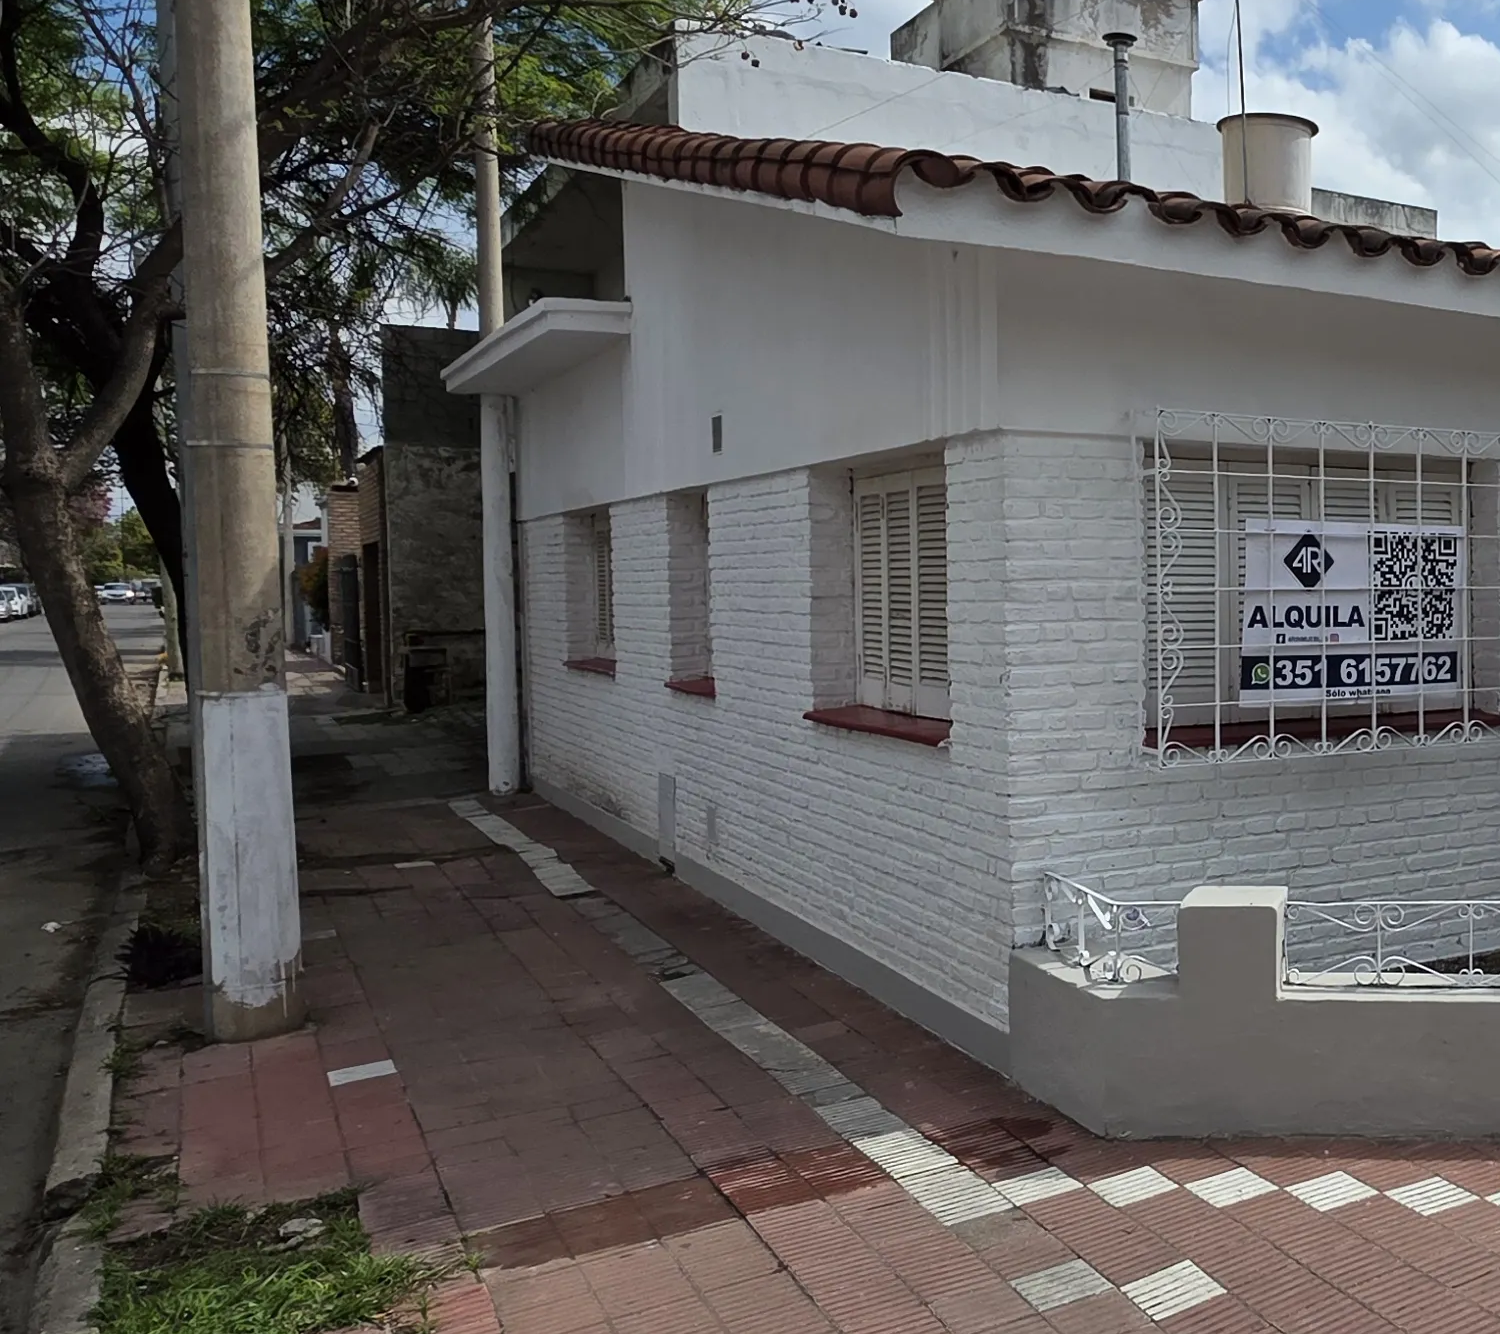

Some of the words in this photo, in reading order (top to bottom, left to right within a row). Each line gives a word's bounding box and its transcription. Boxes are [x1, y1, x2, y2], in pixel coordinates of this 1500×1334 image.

[1247, 605, 1365, 630] ALQUILA
[1340, 655, 1451, 684] 6157762
[1325, 688, 1346, 698] Sólo
